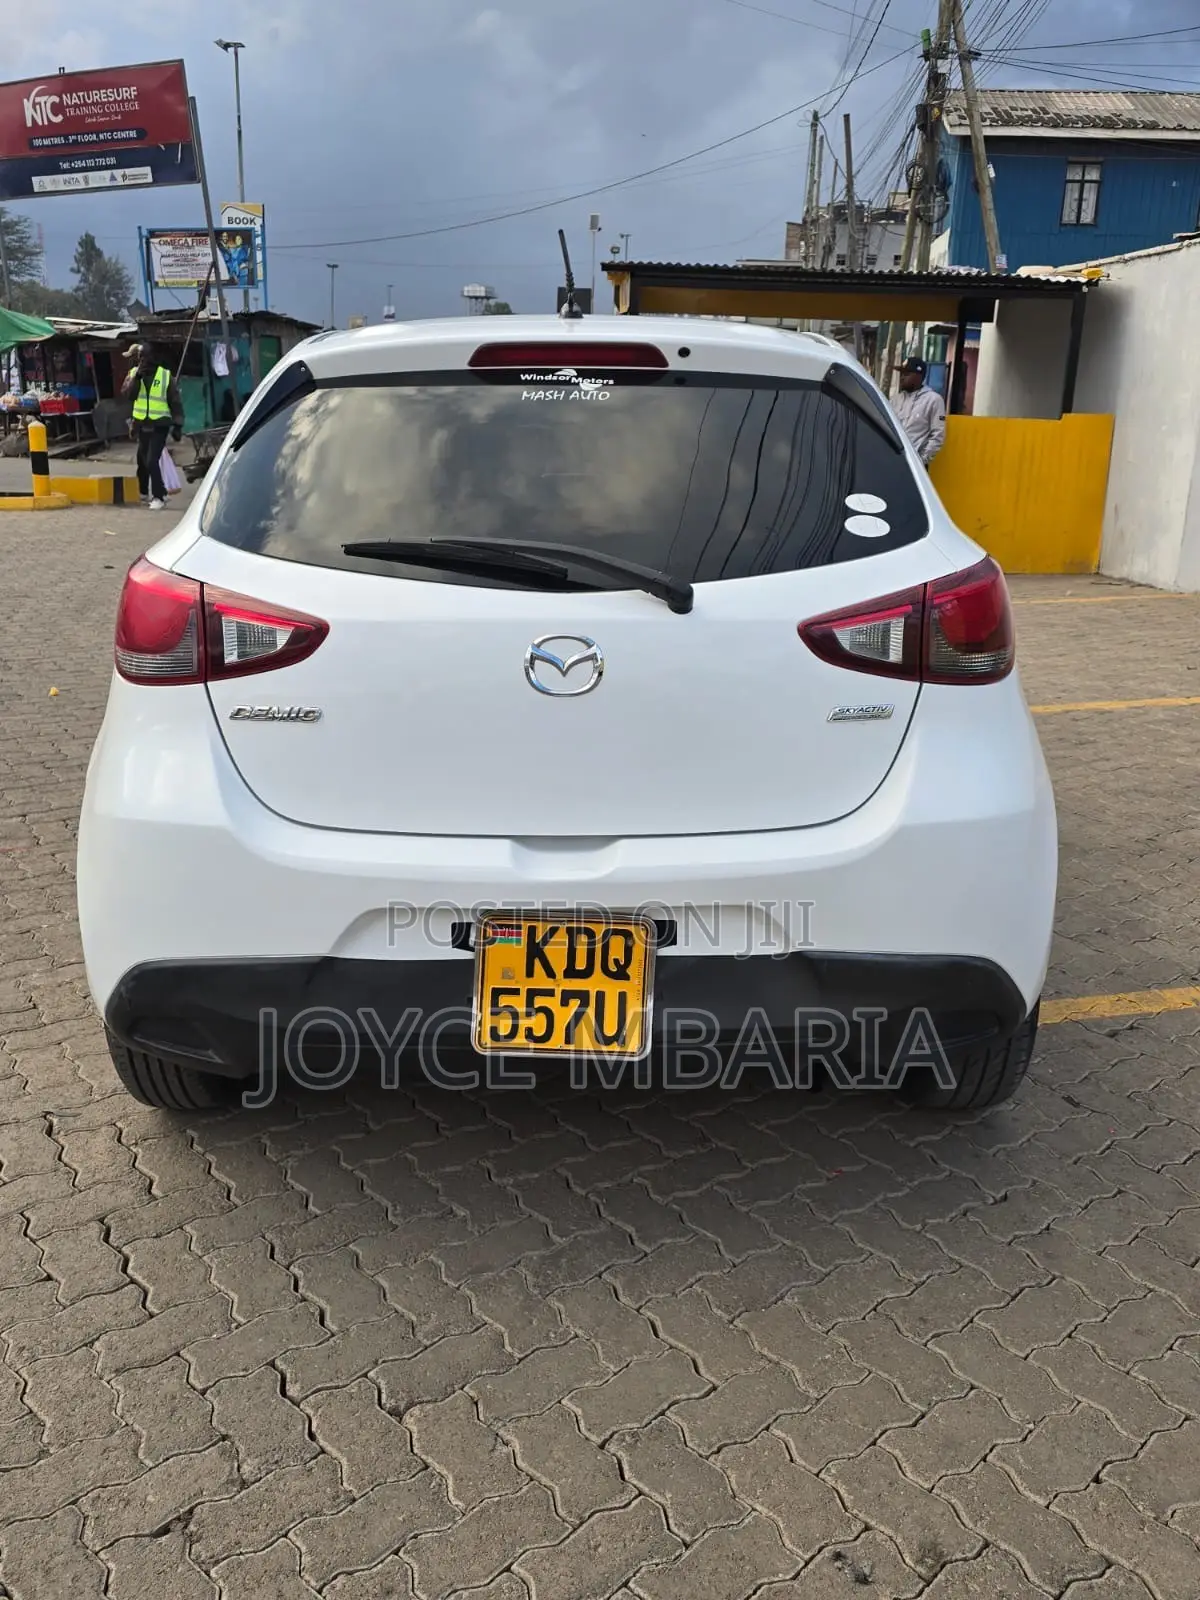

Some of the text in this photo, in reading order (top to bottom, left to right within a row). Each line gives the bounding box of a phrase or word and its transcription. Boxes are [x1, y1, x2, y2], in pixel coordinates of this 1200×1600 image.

[62, 86, 138, 106] NATURESURF
[65, 101, 140, 117] TRAINING COLLEGE
[112, 130, 137, 139] CENTRE
[227, 216, 257, 226] BOOK
[158, 237, 209, 247] OMEGA FIRE
[520, 373, 615, 385] Windsor Motors
[521, 390, 610, 401] MASH AUTO
[229, 704, 322, 723] DEMIO
[837, 705, 890, 714] SKYACTIV
[525, 924, 636, 981] KDQ
[489, 986, 628, 1047] 557U
